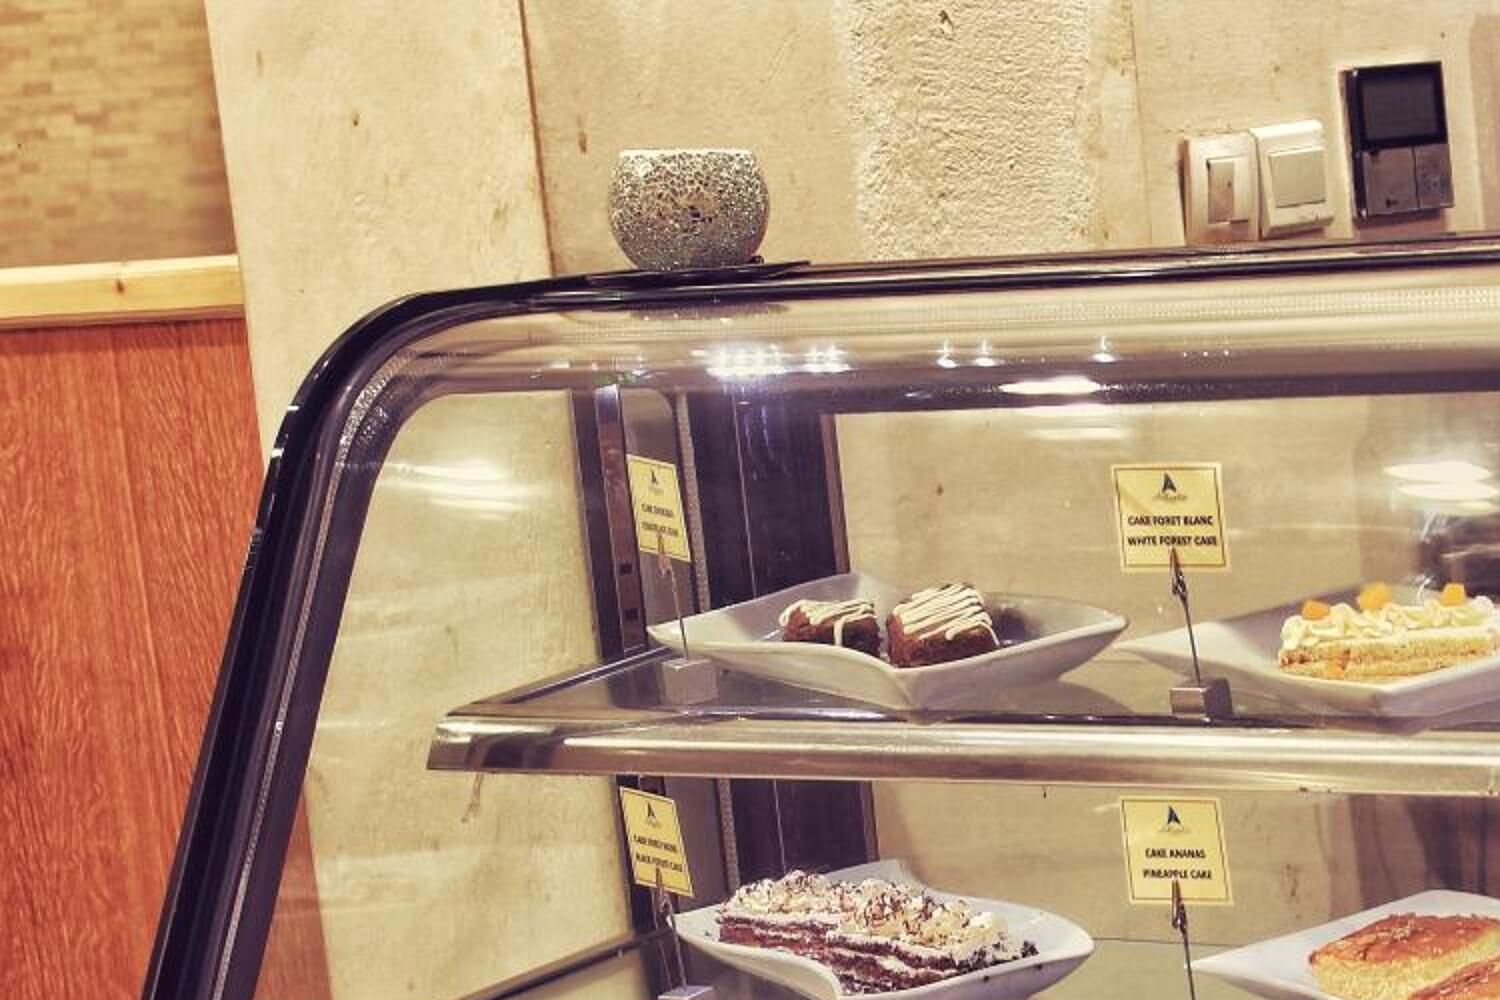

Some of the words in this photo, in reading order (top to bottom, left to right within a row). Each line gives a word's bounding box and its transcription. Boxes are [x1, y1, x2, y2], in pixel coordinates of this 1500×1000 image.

[1128, 515, 1151, 526] CAKE
[1183, 515, 1213, 526] BLANC
[1127, 535, 1157, 546] WHITE
[1160, 535, 1192, 546] FOREST
[1194, 535, 1217, 546] CAKE
[1145, 848, 1167, 859] CAKE
[1169, 848, 1206, 859] ANANAS
[1143, 868, 1187, 880] PINEAPPLE
[1190, 868, 1212, 880] CAKE
